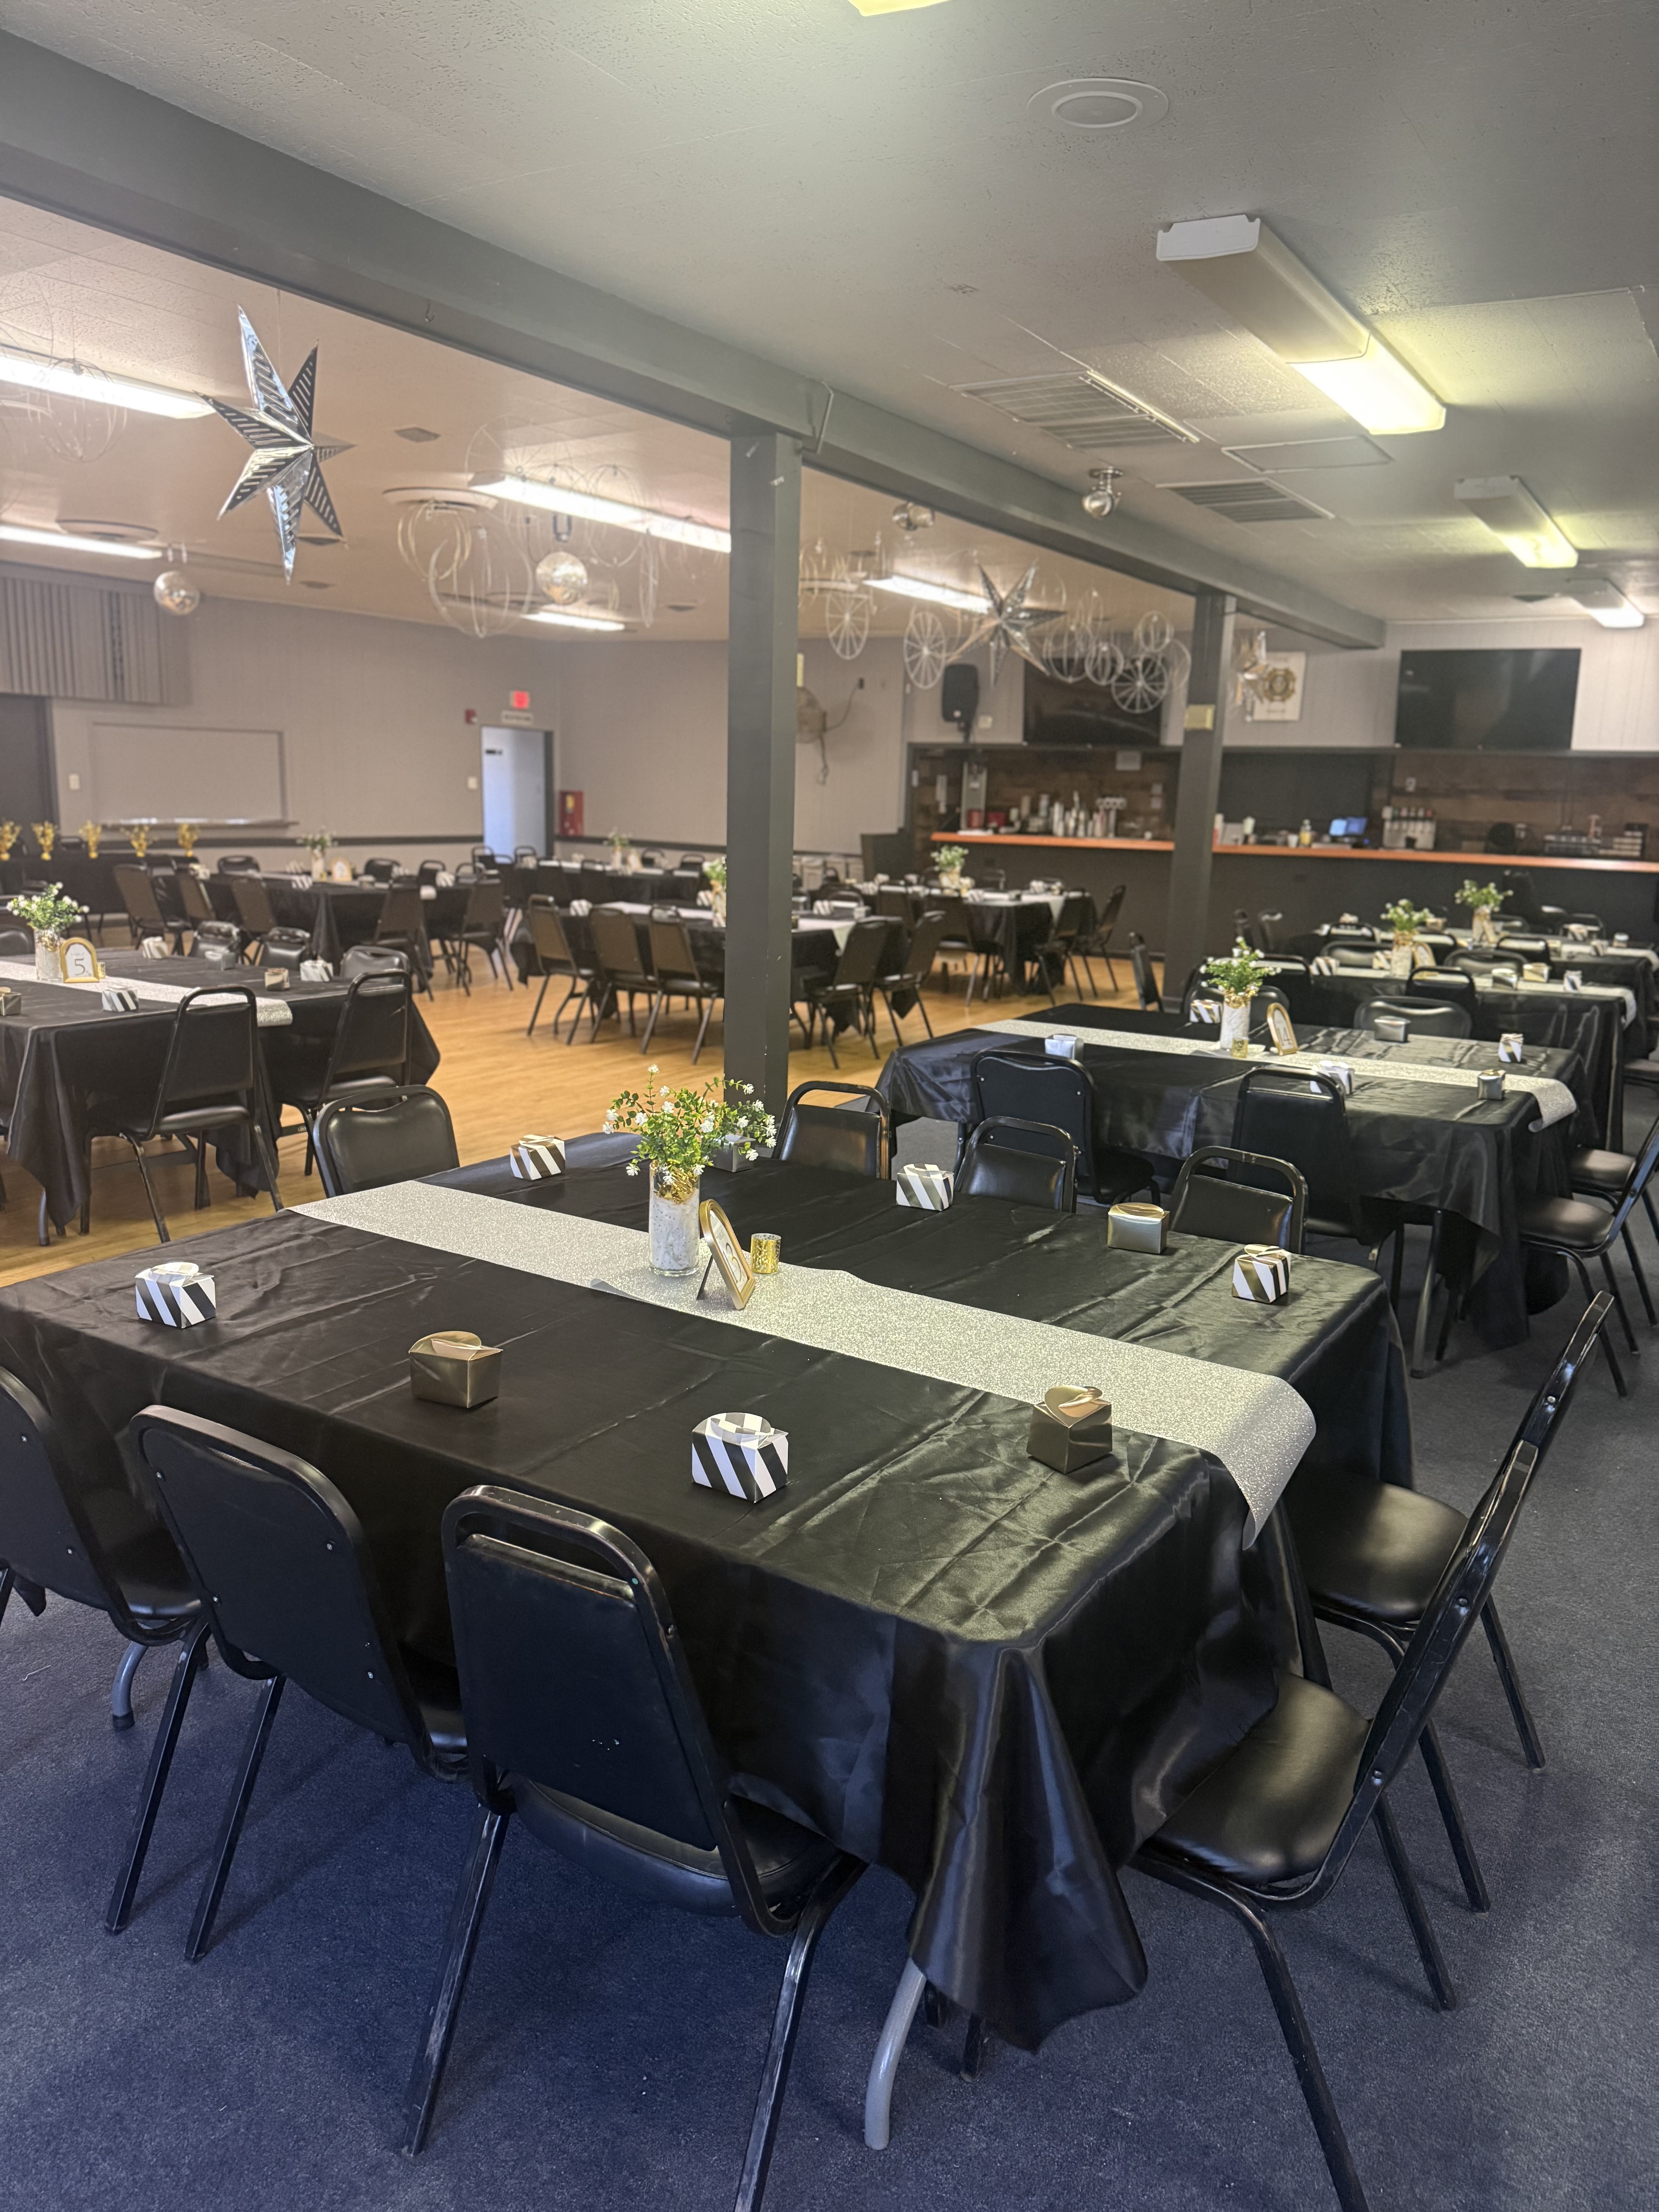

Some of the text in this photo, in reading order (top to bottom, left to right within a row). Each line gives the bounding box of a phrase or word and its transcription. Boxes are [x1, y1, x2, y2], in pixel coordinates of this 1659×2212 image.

[74, 957, 85, 975] 5
[1276, 1027, 1291, 1046] 14
[722, 1242, 742, 1284] 13
